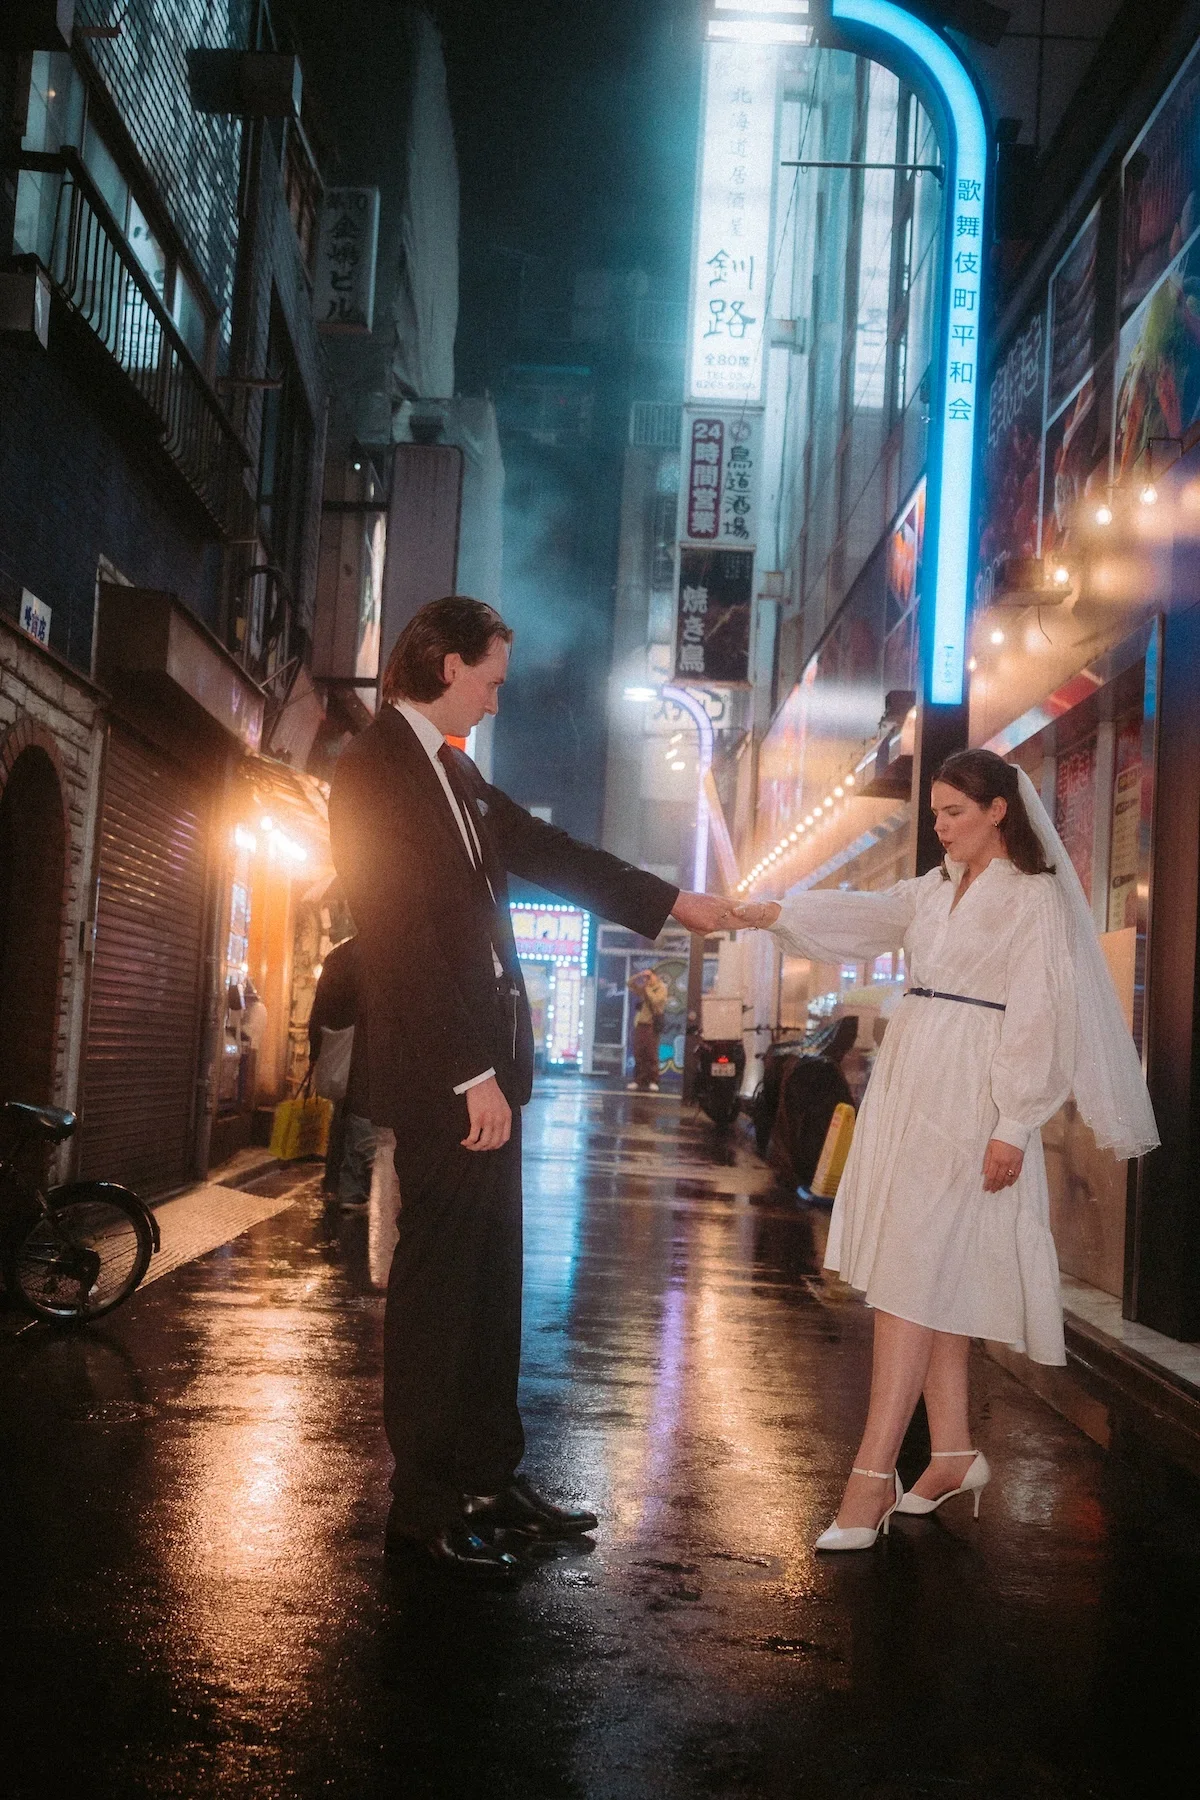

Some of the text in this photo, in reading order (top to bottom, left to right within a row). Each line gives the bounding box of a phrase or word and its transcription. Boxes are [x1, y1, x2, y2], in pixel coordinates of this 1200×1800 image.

[703, 249, 756, 338] 釧路
[948, 178, 981, 421] 歌舞伎町平和会
[691, 422, 721, 534] 24時間営業
[723, 445, 753, 540] 鳥道酒場
[680, 585, 708, 673] 焼き鳥
